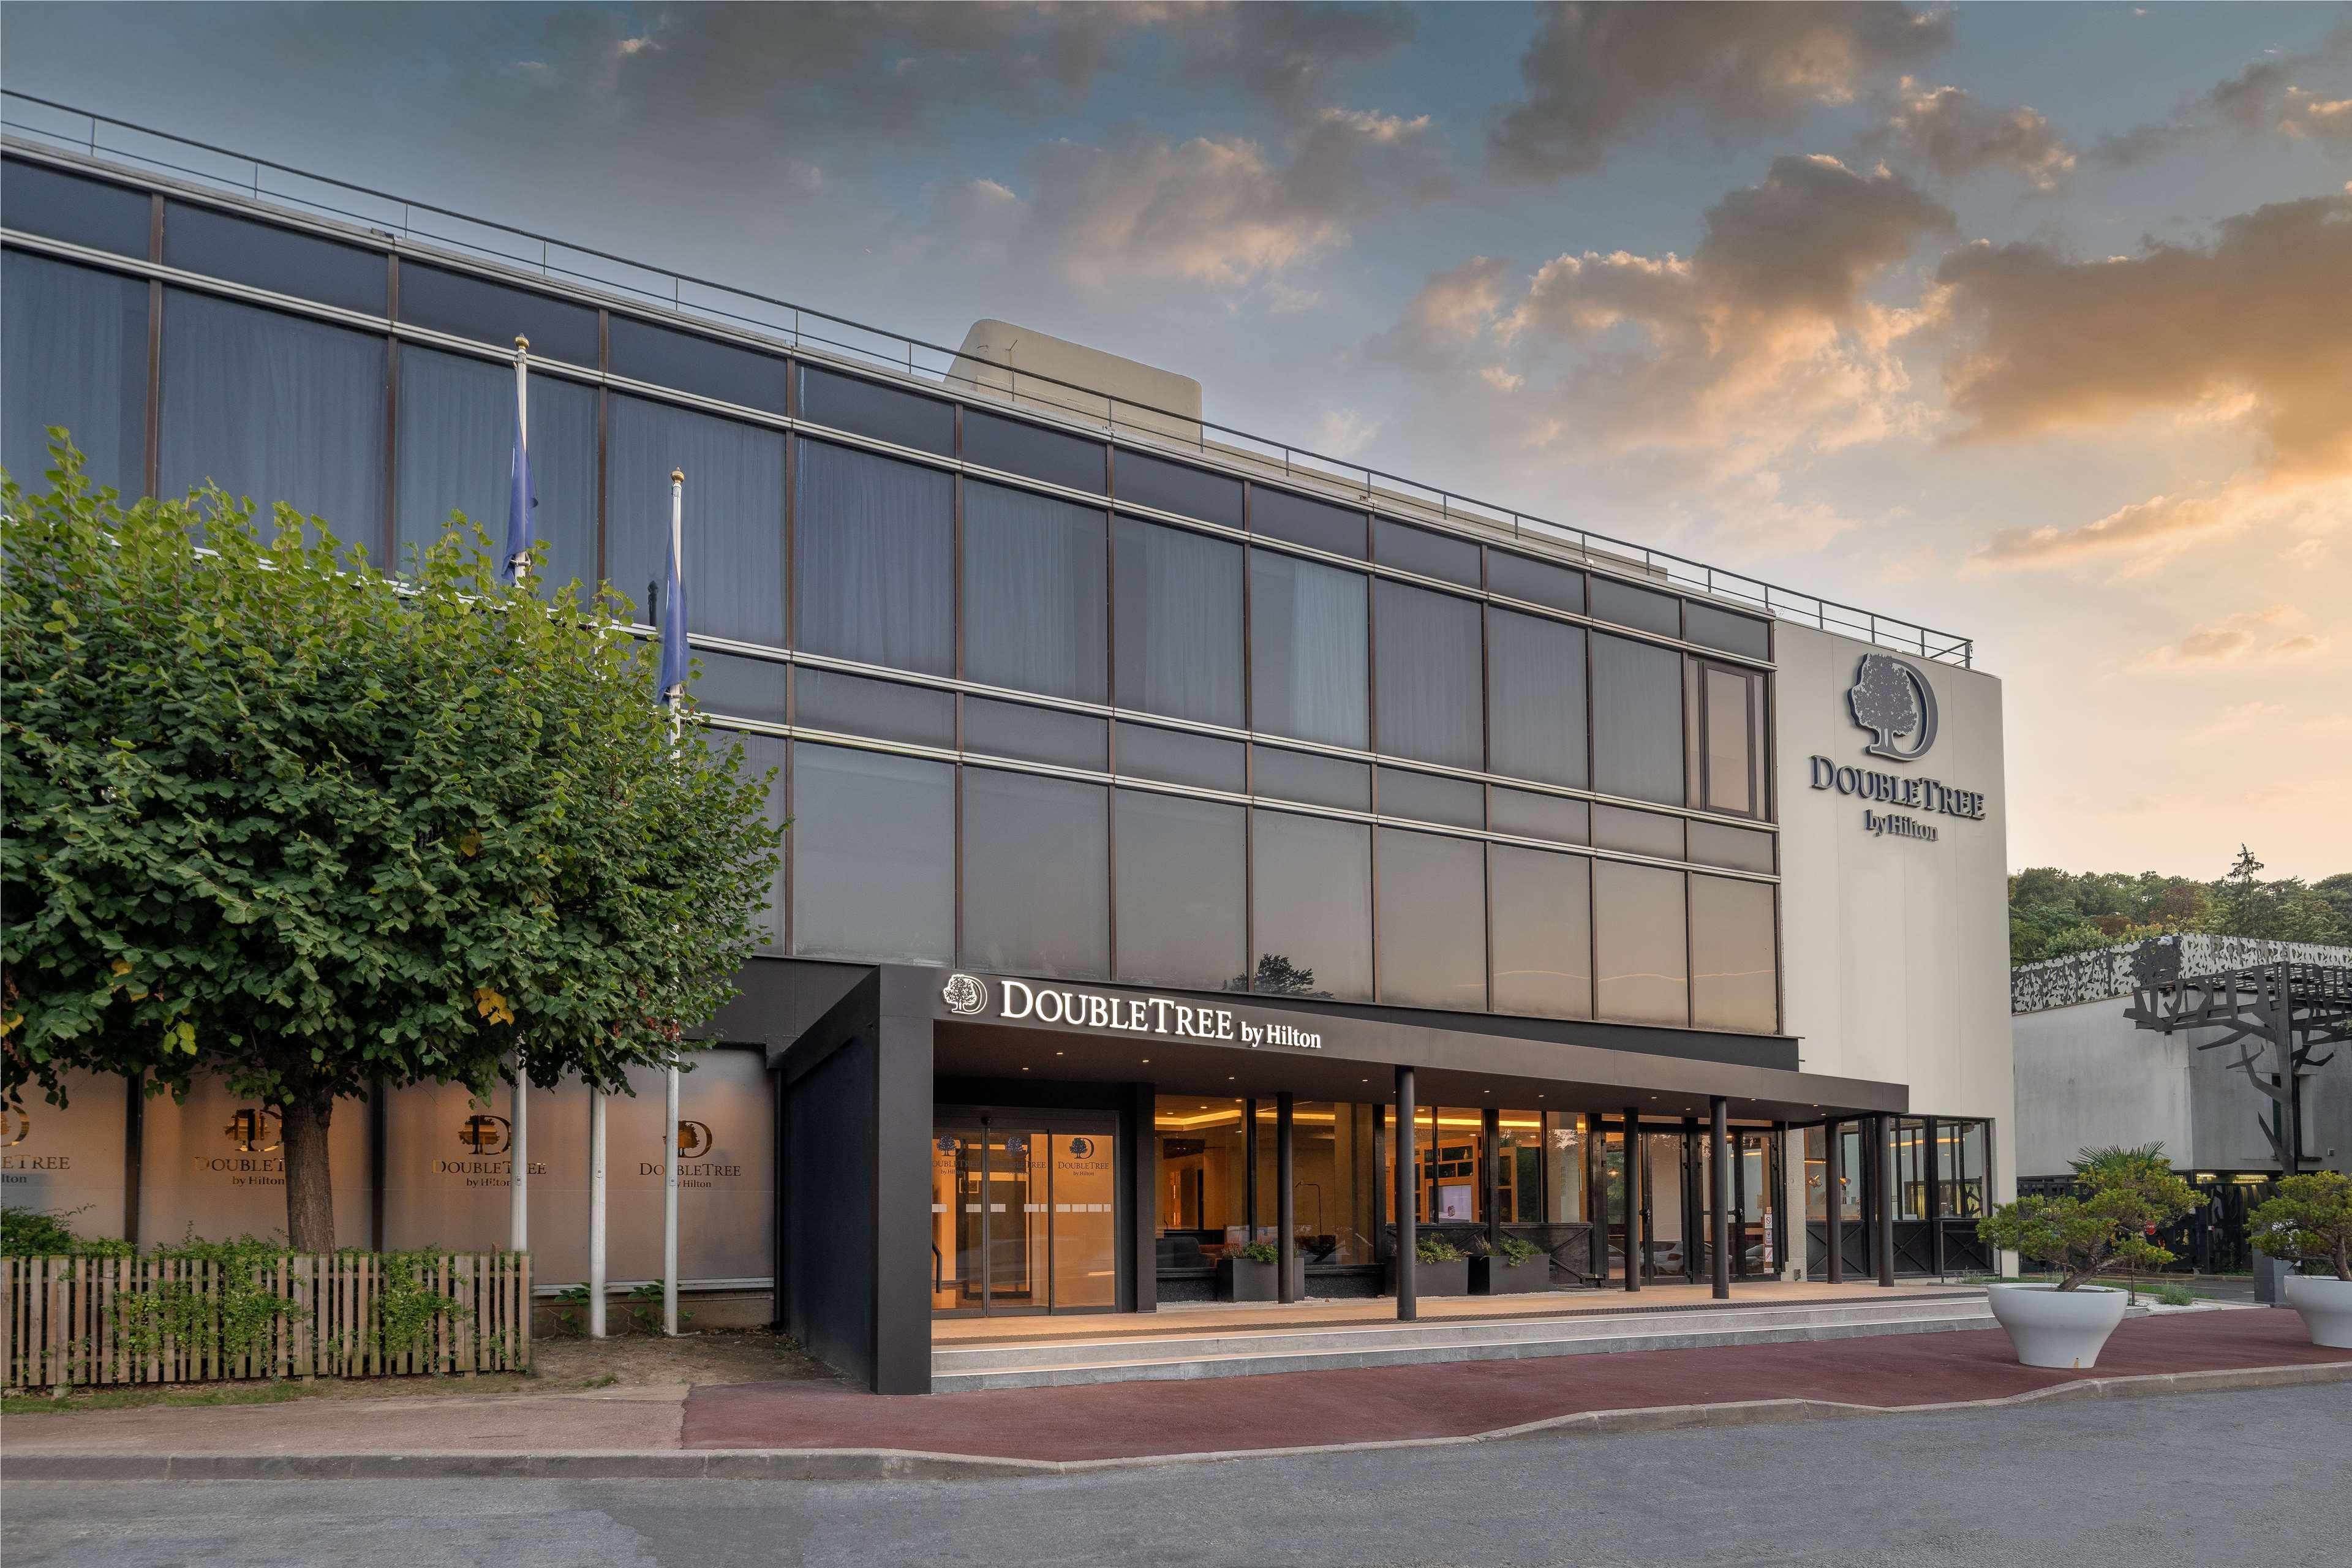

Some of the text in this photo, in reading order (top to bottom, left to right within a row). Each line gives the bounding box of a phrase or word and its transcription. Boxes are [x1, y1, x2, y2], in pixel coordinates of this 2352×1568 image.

[1810, 755, 1986, 820] DOUBLETREE
[1864, 809, 1940, 842] by Hilton
[1000, 981, 1321, 1048] DOUBLETREE by Hilton
[1, 1155, 70, 1169] ETREE
[193, 1156, 284, 1172] DOUBLET
[431, 1159, 546, 1175] DOUBLETEE
[1058, 1161, 1109, 1169] DOUBLETREE
[639, 1163, 741, 1176] DOBLETREE
[1, 1174, 27, 1183] lton
[233, 1177, 284, 1186] by Hilton
[467, 1178, 478, 1188] by
